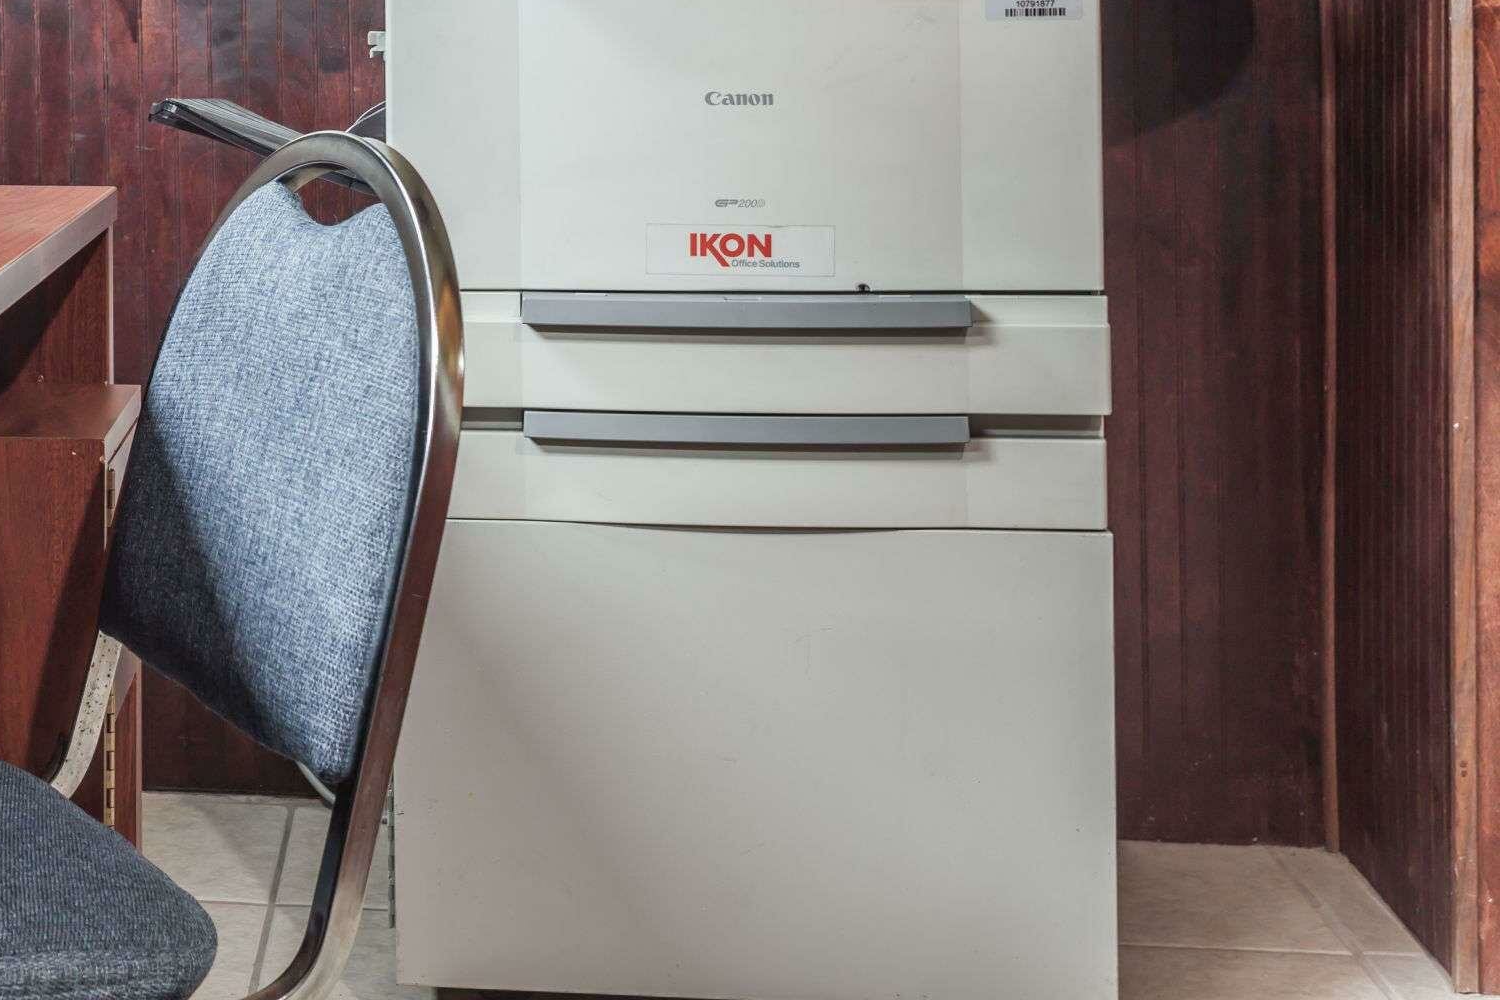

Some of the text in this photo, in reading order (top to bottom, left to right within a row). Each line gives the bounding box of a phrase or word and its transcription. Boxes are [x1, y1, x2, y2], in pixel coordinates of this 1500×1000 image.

[704, 91, 774, 106] Canon
[689, 232, 772, 268] IKON
[731, 259, 800, 269] Office Solutions
